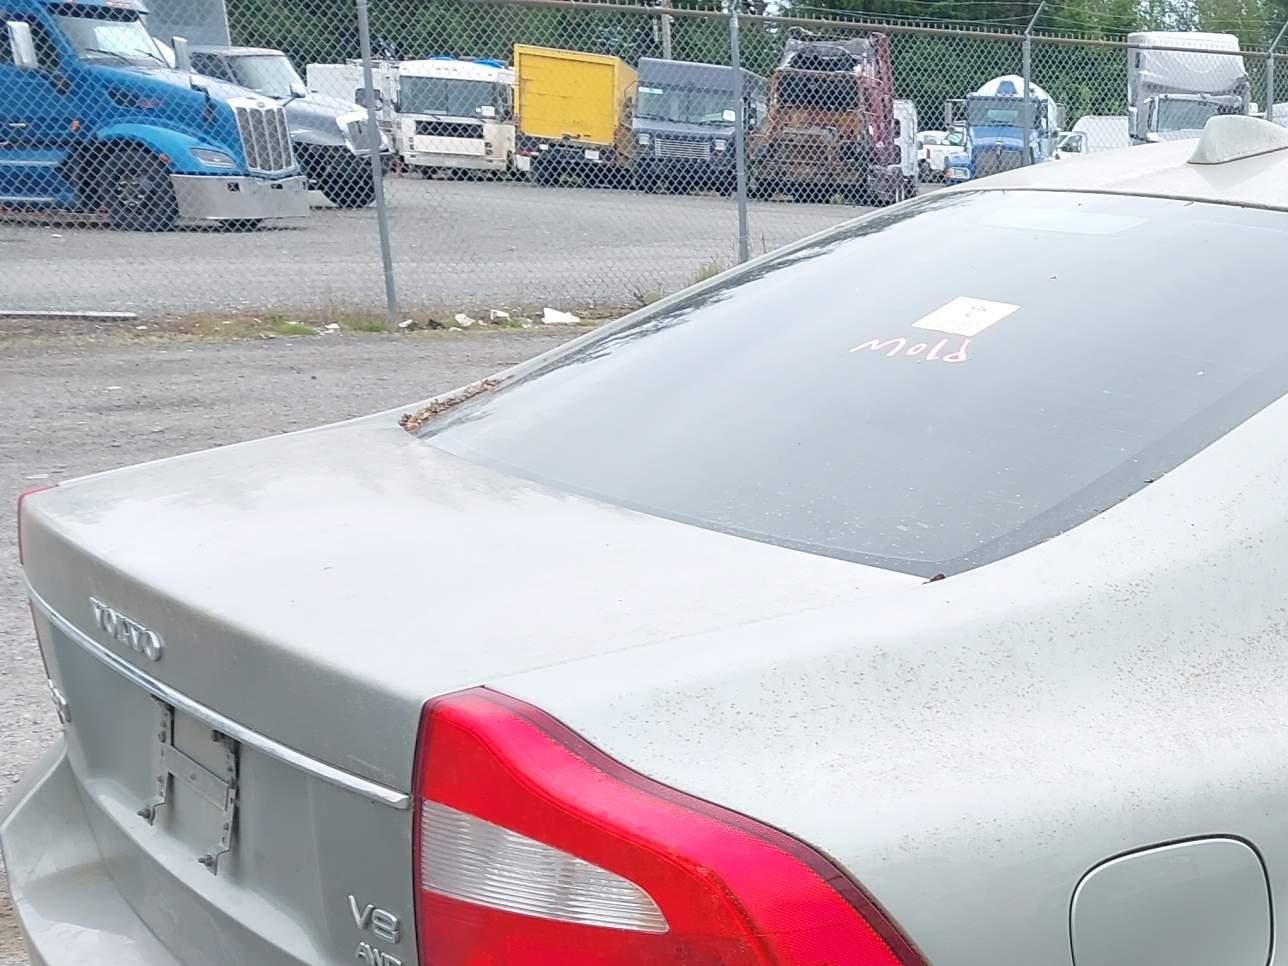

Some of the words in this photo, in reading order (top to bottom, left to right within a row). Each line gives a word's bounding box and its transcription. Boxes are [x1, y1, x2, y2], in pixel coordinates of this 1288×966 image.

[848, 336, 972, 363] Mold
[89, 596, 165, 662] VOLVO
[348, 894, 400, 945] V8
